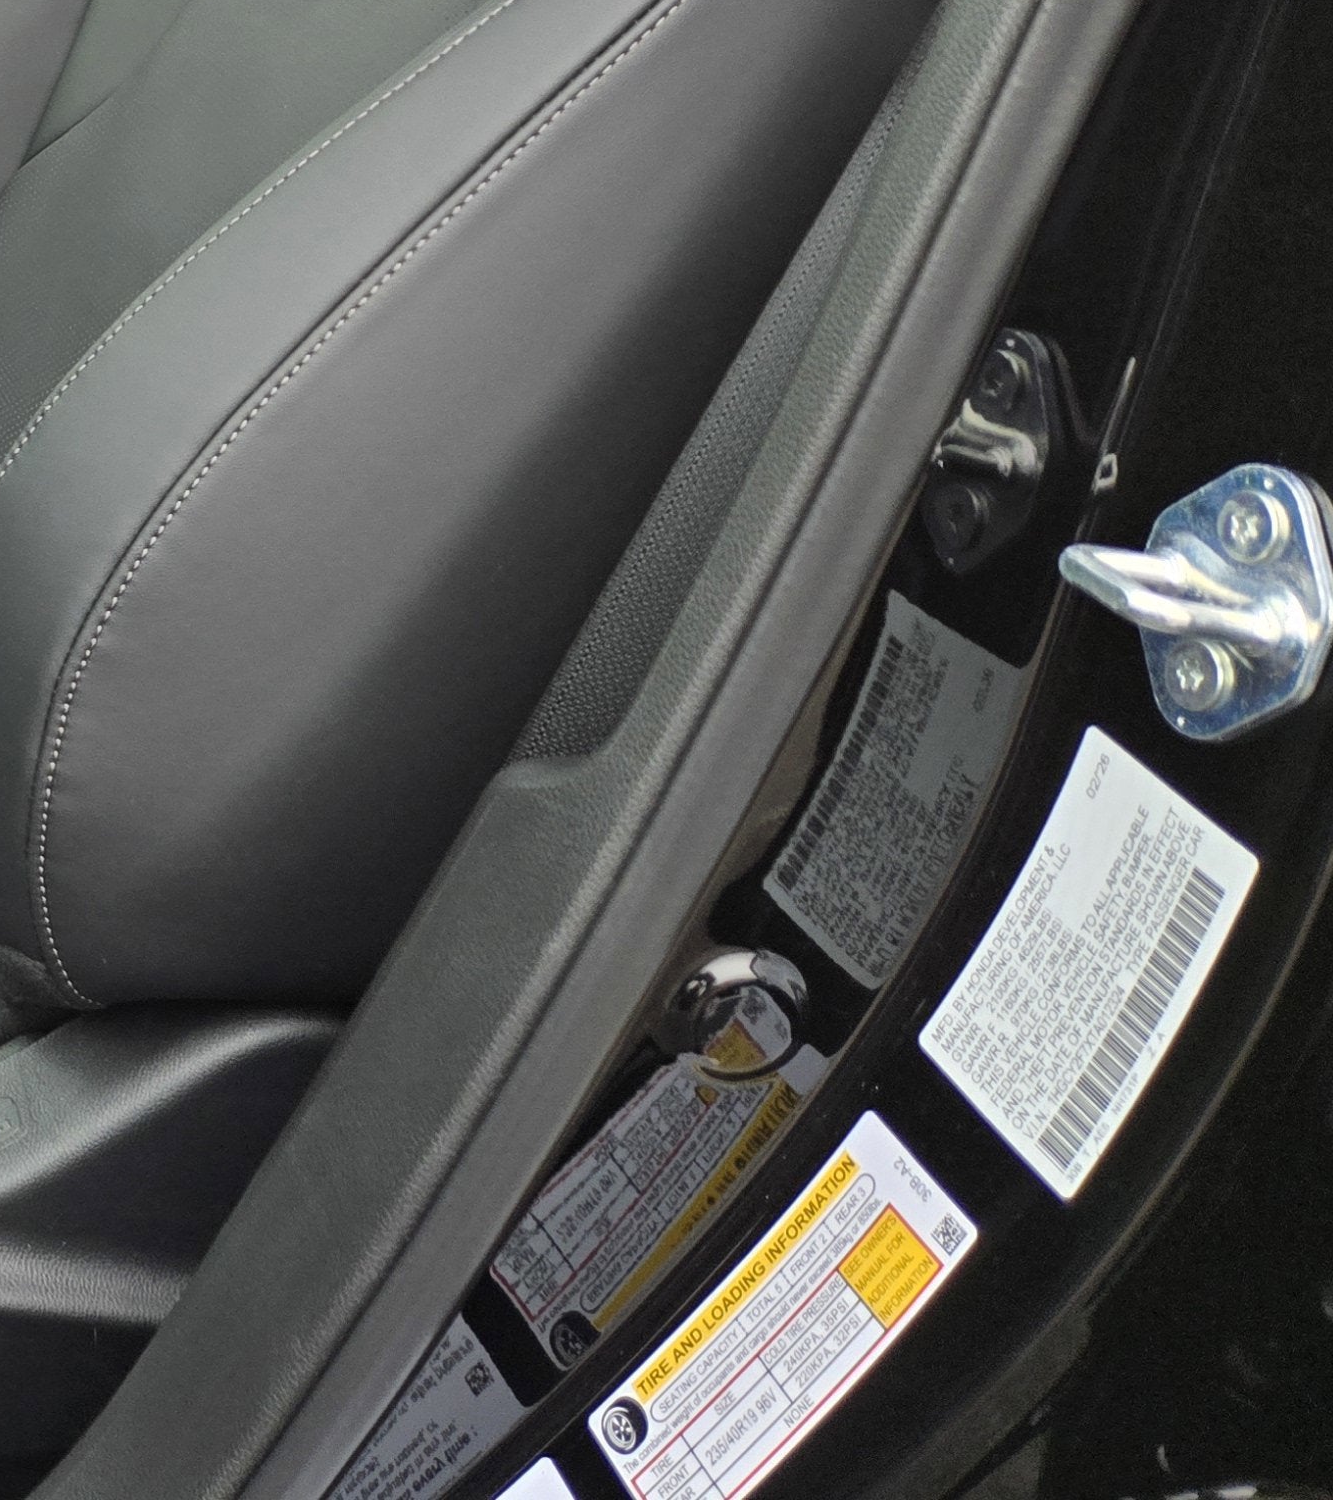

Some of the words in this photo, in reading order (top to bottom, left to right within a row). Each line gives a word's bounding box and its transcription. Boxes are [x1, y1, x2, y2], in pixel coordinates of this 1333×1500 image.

[941, 948, 1012, 1053] MANUFACTURING
[1008, 928, 1024, 950] OF
[1052, 841, 1071, 871] LLC
[952, 989, 969, 1011] BY
[963, 947, 996, 994] HONDA
[992, 853, 1049, 949] DEVELOPMENT
[1043, 843, 1054, 857] &
[1126, 939, 1150, 975] TYPE
[1144, 856, 1190, 939] PASSENGER
[1185, 824, 1205, 857] CAR
[981, 1063, 1005, 1094] THIS
[1000, 1009, 1041, 1065] VEHICLE
[1036, 933, 1085, 1011] CONFORMS
[1082, 911, 1097, 933] TO
[1092, 888, 1110, 915] ALL
[1105, 804, 1149, 890] APPLICABLE
[1000, 1087, 1025, 1119] AND
[1021, 1044, 1053, 1088] THEFT
[1048, 962, 1103, 1048] PREVENTION
[1099, 879, 1147, 963] STANDARDS
[1141, 863, 1154, 881] IN
[1149, 805, 1180, 864] EFFECT
[951, 1021, 981, 1063] GVWR
[984, 965, 1017, 1013] 2100KG
[960, 1033, 990, 1074] GAWR
[986, 1022, 997, 1034] F
[995, 975, 1028, 1022] 1160KG
[970, 1043, 1000, 1084] GAWR
[996, 1031, 1008, 1045] R
[1009, 985, 1038, 1026] 970KG
[989, 1047, 1033, 1107] FEDERAL
[1029, 998, 1064, 1049] MOTOR
[1060, 942, 1097, 1000] VEHICLE
[1011, 1106, 1030, 1130] ON
[1025, 1079, 1049, 1109] THE
[1044, 1045, 1071, 1081] DATE
[1067, 1024, 1084, 1046] OF
[1079, 923, 1141, 1026] MANUFACTURE
[1136, 869, 1167, 924] SHOWN
[637, 1357, 673, 1396] TIRE
[669, 1325, 704, 1362] AND
[701, 1260, 766, 1330] LOADING
[764, 1153, 856, 1264] INFORMATION
[658, 1371, 697, 1414] SEATING
[694, 1327, 739, 1376] CAPACITY
[746, 1290, 775, 1322] TOTAL
[773, 1282, 782, 1294] 5
[789, 1240, 820, 1276] FRONT
[818, 1232, 827, 1244] 2
[834, 1193, 859, 1225] REAR
[857, 1185, 867, 1197] 3
[843, 1254, 862, 1278] SEE
[855, 1250, 889, 1292] MANUAL
[885, 1230, 905, 1255] FOR
[866, 1250, 914, 1306] ADDITIONAL
[878, 1254, 934, 1322] INFORMATION
[623, 1455, 639, 1474] The
[636, 1423, 672, 1461] combined
[669, 1402, 694, 1430] weight
[691, 1393, 704, 1406] of
[733, 1345, 749, 1364] and
[748, 1325, 770, 1351] cargo
[767, 1301, 790, 1328] should
[788, 1280, 810, 1306] never
[851, 1222, 860, 1234] or
[763, 1336, 787, 1364] COLD
[784, 1318, 804, 1341] TIRE
[801, 1275, 843, 1323] PRESSURE
[820, 1298, 849, 1331] 35PSI
[832, 1313, 862, 1347] 32PSI
[704, 1407, 758, 1466] 235/40R19
[754, 1386, 778, 1414] 96V
[713, 1390, 736, 1416] SIZE
[783, 1393, 814, 1428] NONE
[651, 1452, 674, 1478] TIRE
[657, 1463, 690, 1498] FRONT
